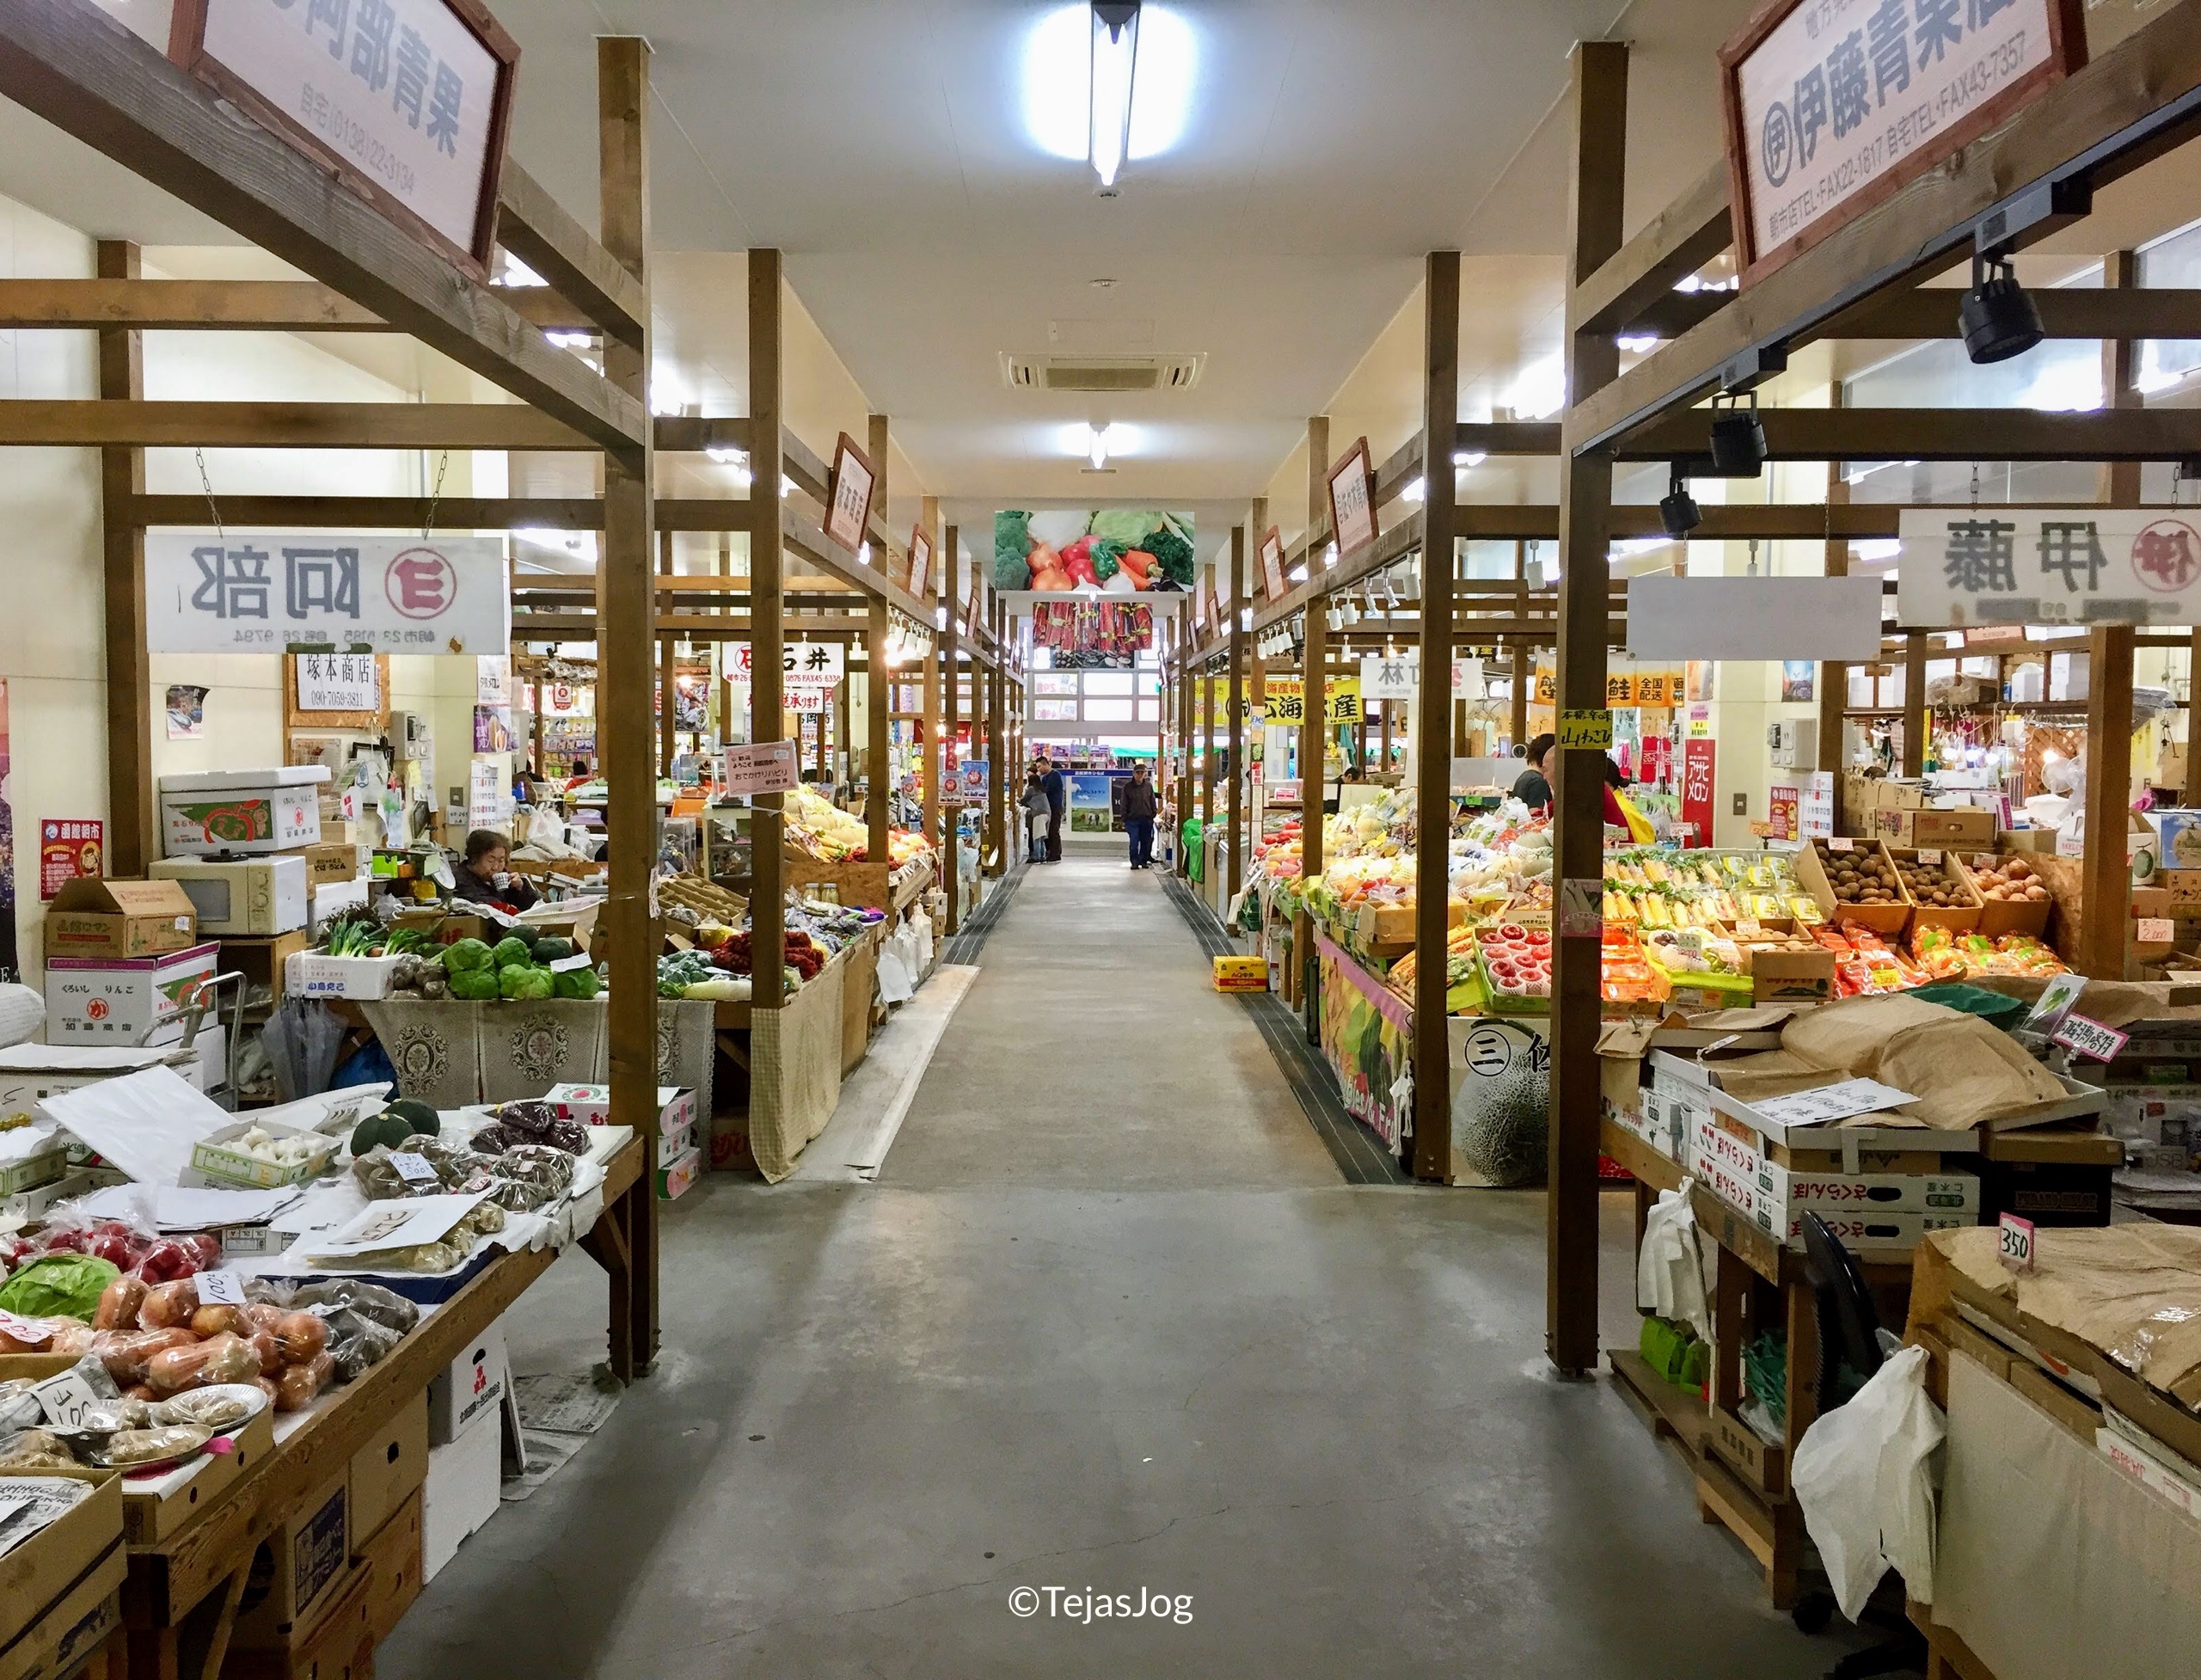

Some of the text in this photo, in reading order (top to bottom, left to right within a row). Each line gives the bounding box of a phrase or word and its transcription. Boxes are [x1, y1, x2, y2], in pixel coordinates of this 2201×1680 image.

[307, 654, 370, 684] 塚本商店
[1608, 678, 1630, 701] 鮭
[1640, 678, 1663, 689] 全国
[1640, 690, 1663, 701] 配送
[105, 985, 133, 994] りんご
[1793, 1183, 1867, 1200] さくらんぼ
[1790, 1221, 1864, 1237] さくらぼ
[2002, 1228, 2028, 1259] 350
